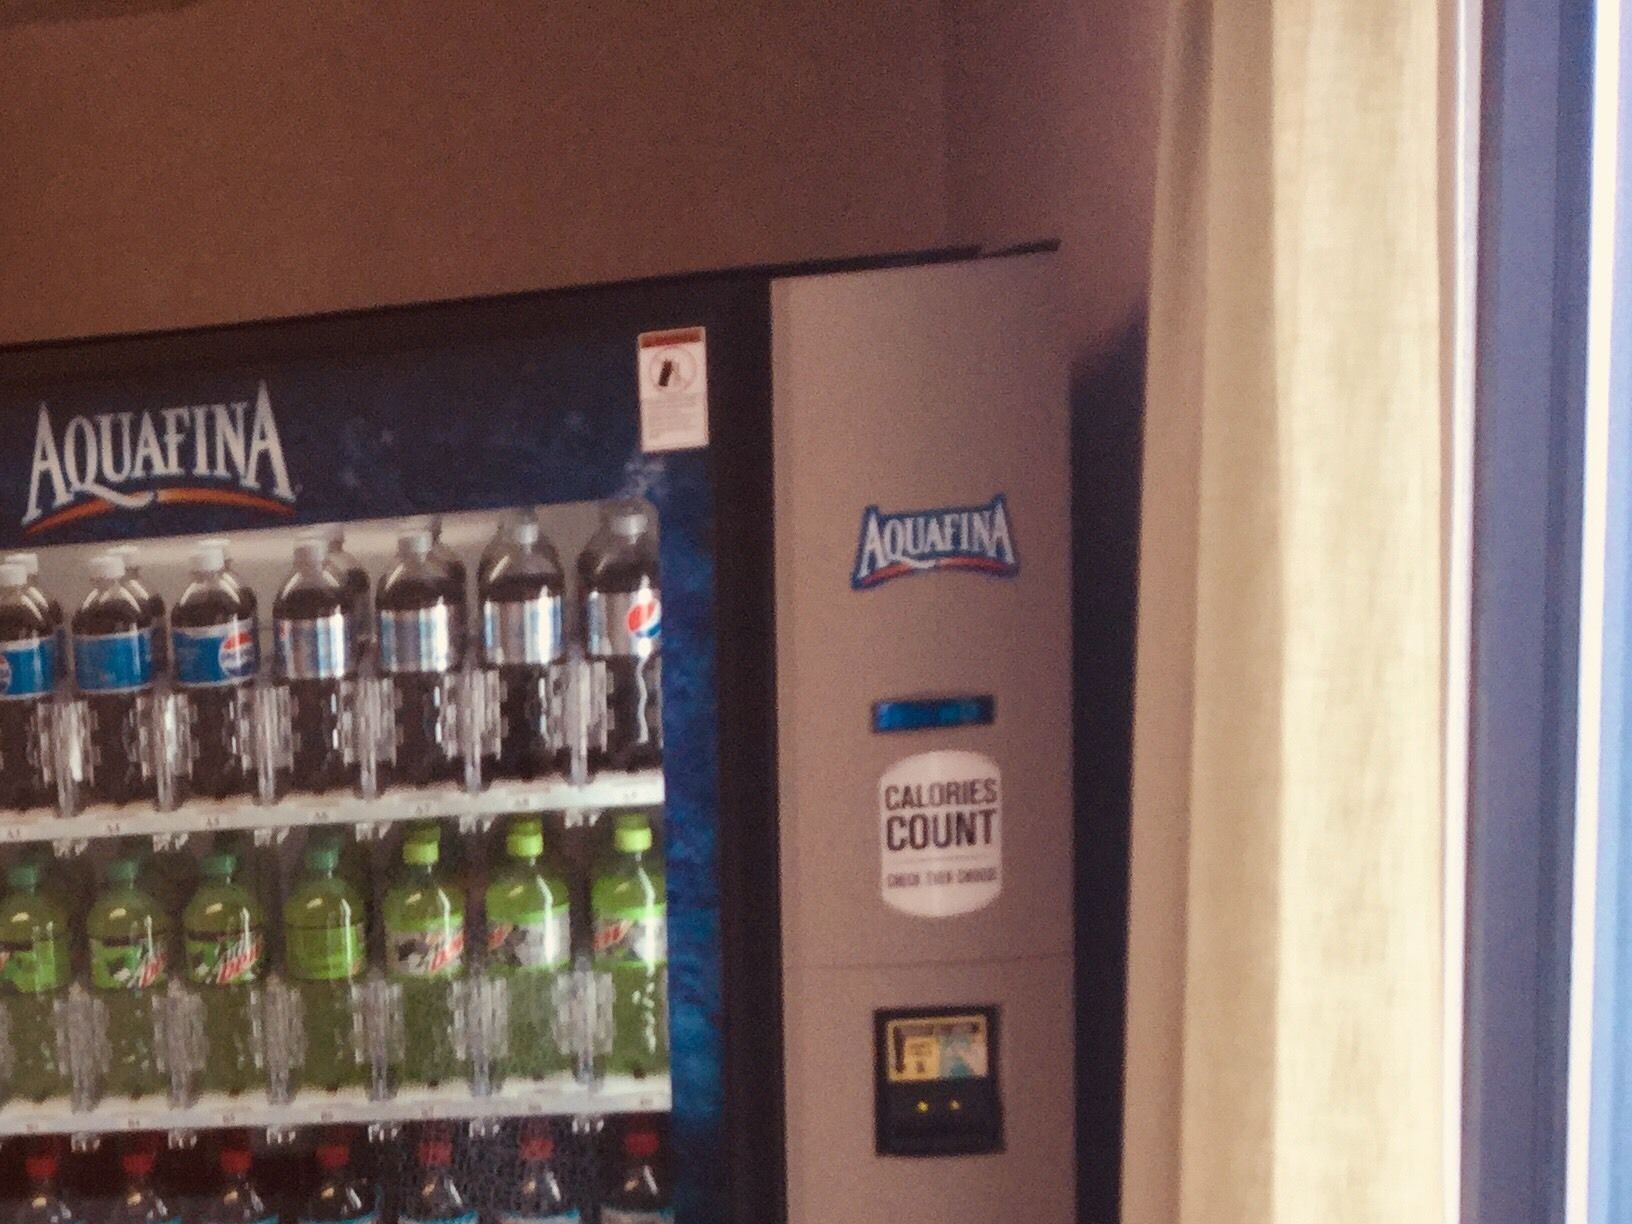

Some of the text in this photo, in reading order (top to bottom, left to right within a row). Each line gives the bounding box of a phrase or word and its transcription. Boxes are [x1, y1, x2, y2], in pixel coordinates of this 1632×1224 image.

[21, 378, 298, 527] AQUAFINA
[855, 498, 1017, 580] AQUAFINA
[883, 777, 999, 812] CALORIES
[885, 808, 998, 852] COUNT
